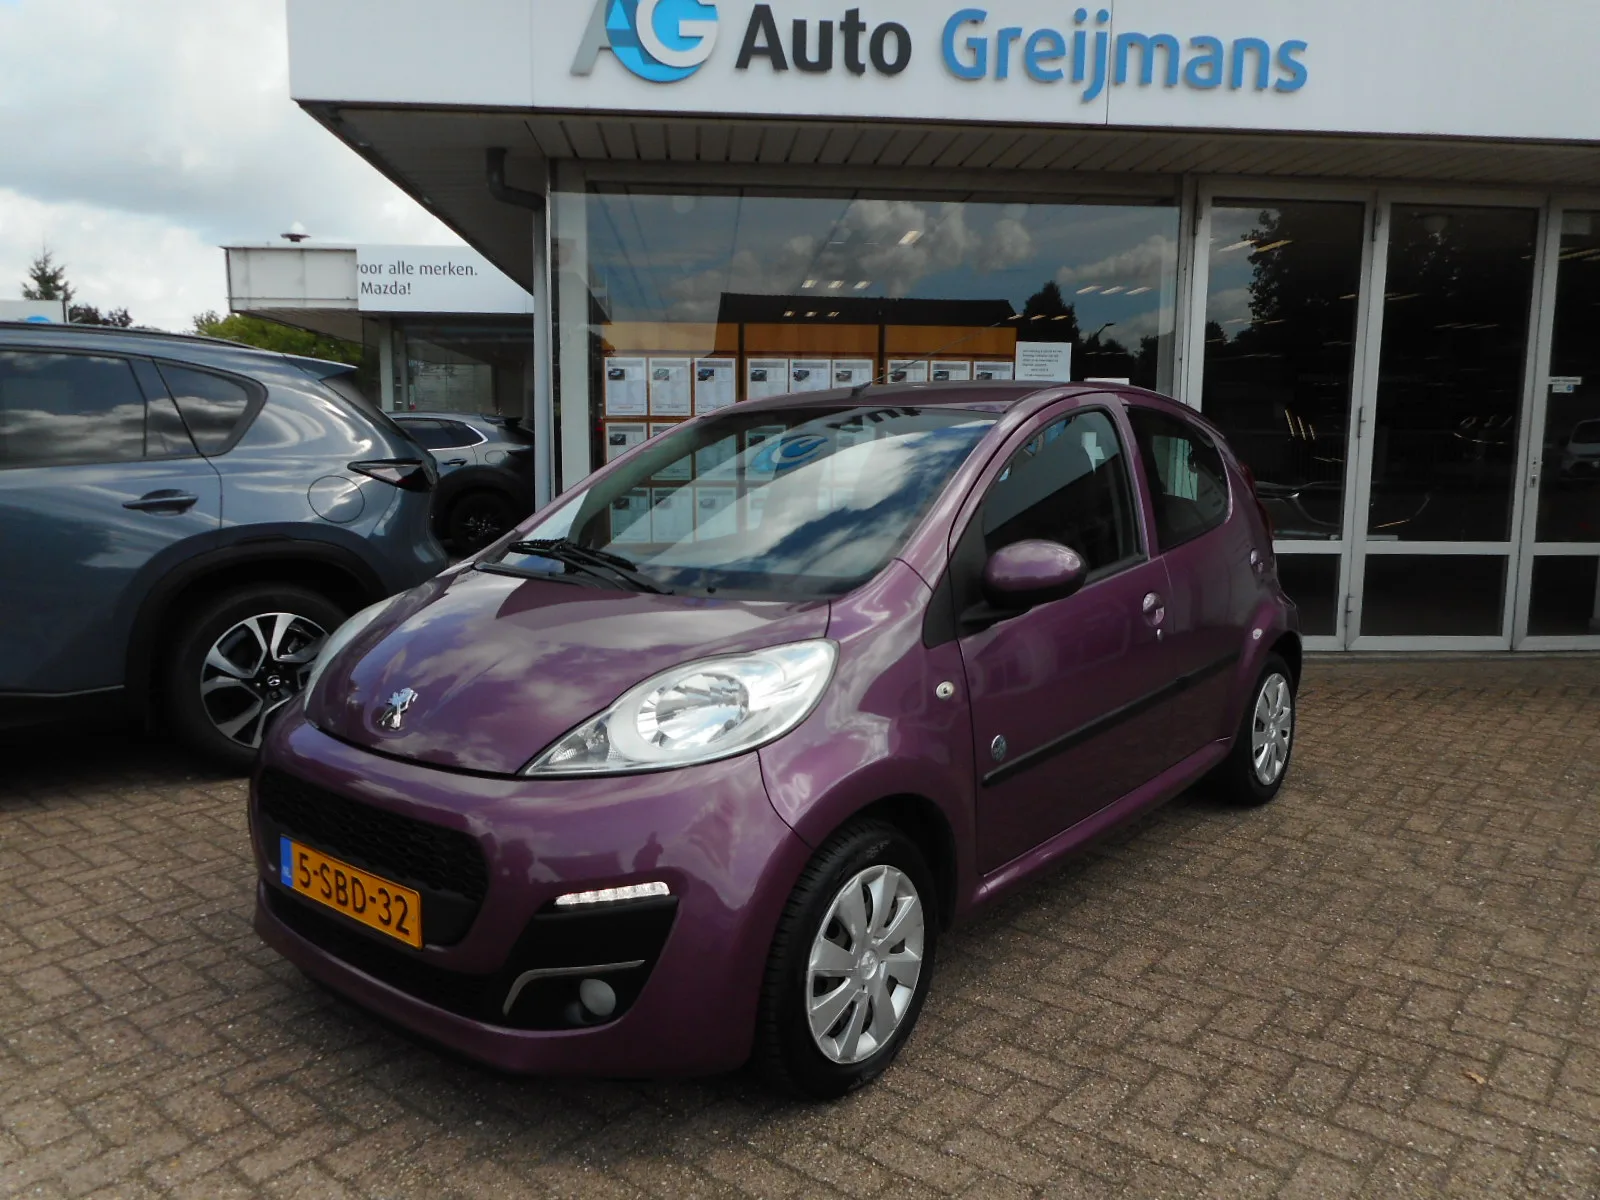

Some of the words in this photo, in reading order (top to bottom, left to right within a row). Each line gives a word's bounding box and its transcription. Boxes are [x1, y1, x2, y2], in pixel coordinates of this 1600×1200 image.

[735, 4, 912, 75] Auto
[942, 8, 1309, 101] Greijmans
[357, 263, 383, 275] oor
[389, 260, 414, 275] alle
[420, 261, 478, 276] merken.
[361, 281, 411, 295] Mazda!
[299, 852, 410, 936] 5-SBD-32
